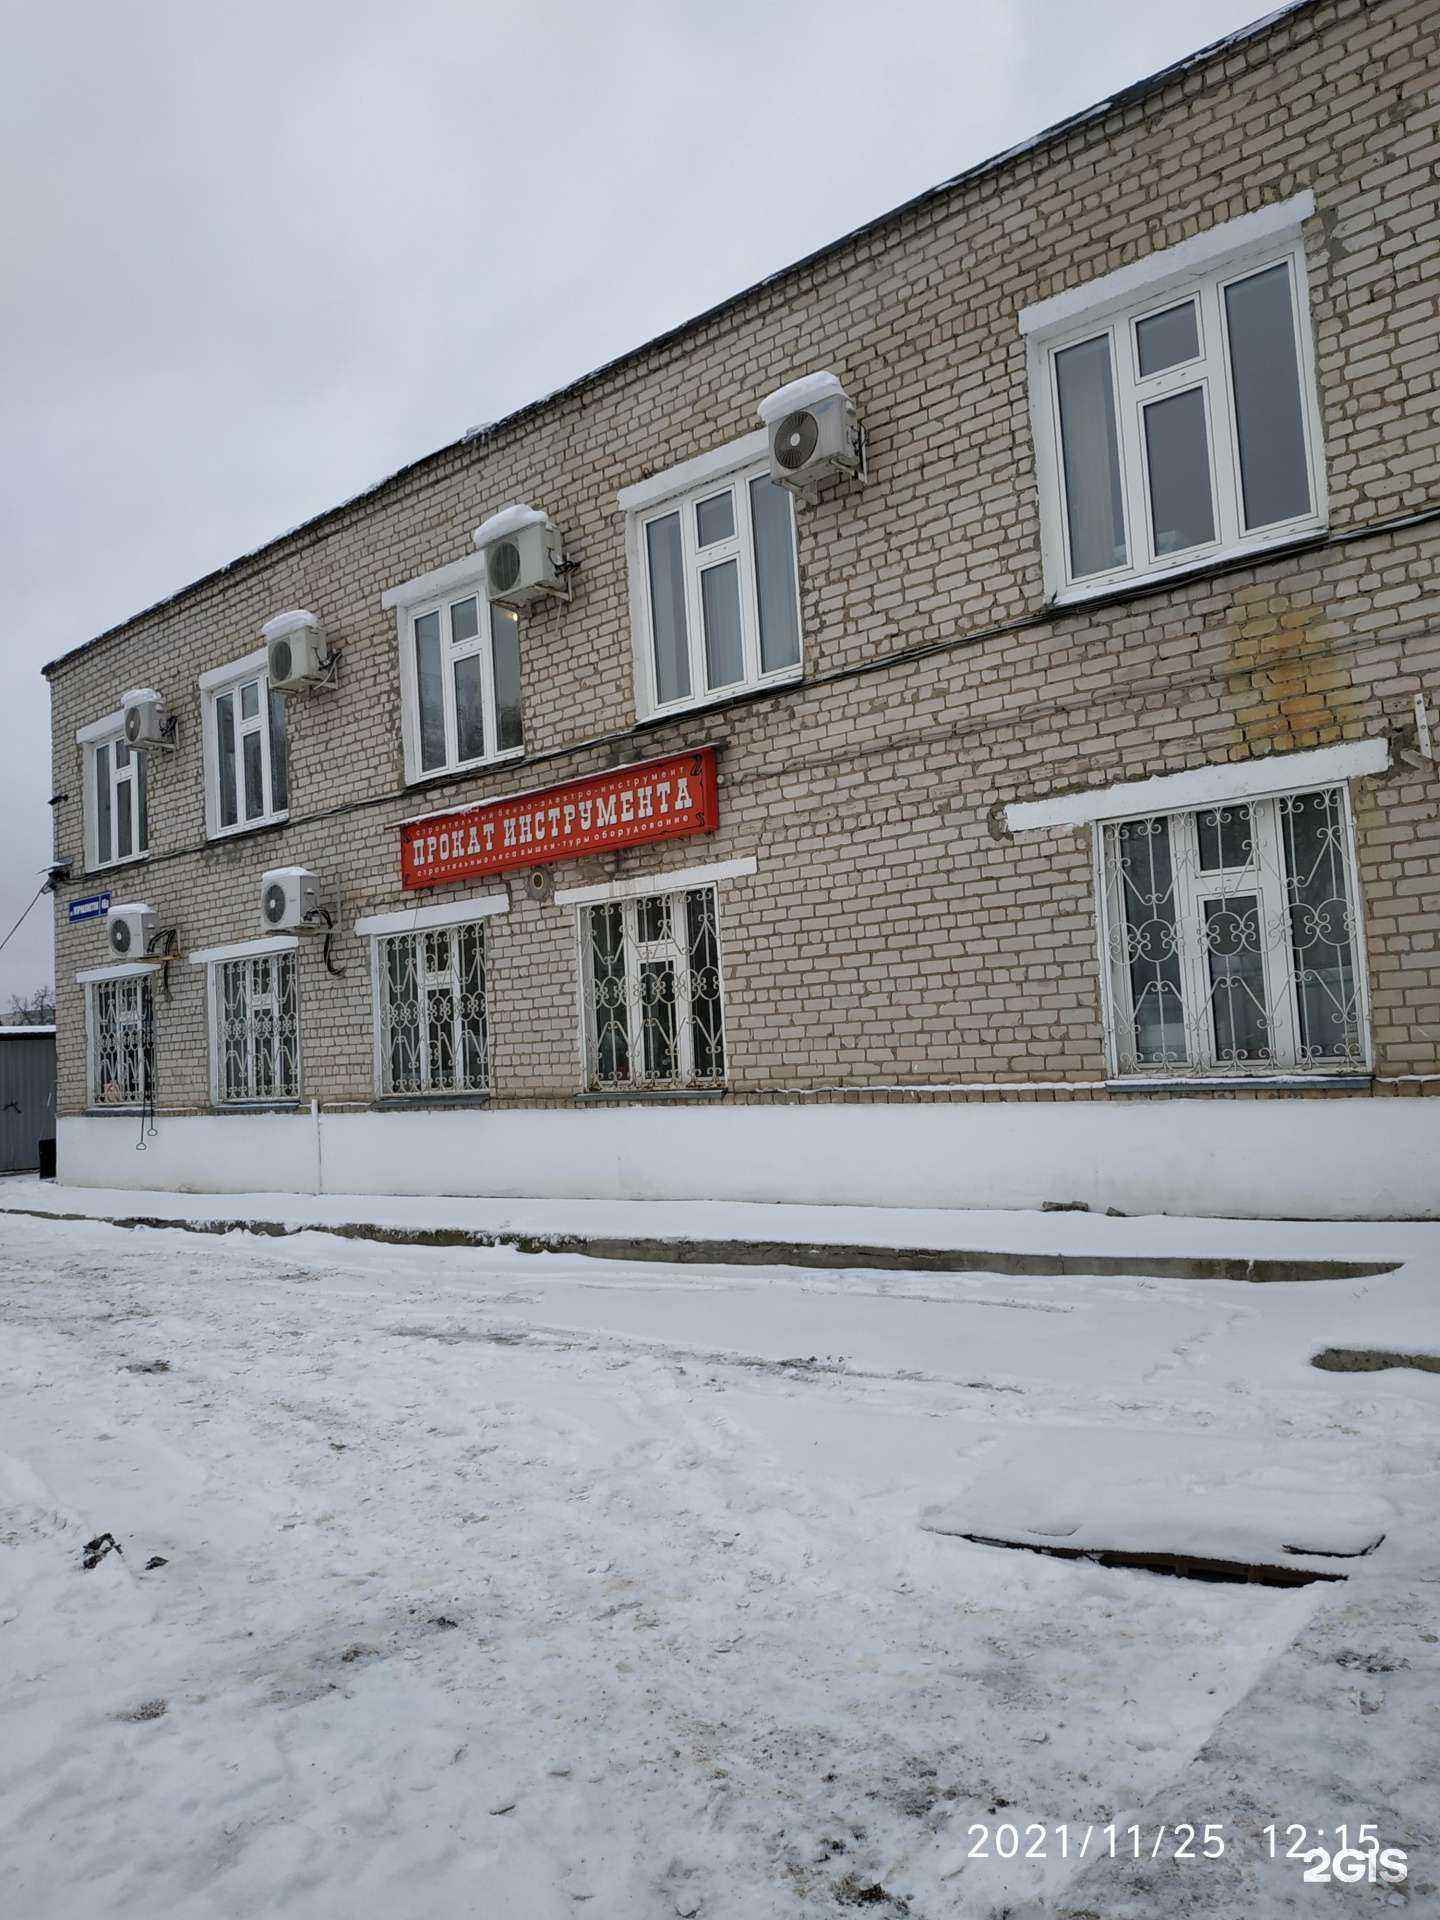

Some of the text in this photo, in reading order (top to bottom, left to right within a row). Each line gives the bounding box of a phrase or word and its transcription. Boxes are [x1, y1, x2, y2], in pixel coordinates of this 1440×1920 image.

[412, 777, 693, 867] ПРОКАТ ИНСТРУМЕНТА
[594, 814, 689, 841] оборудование
